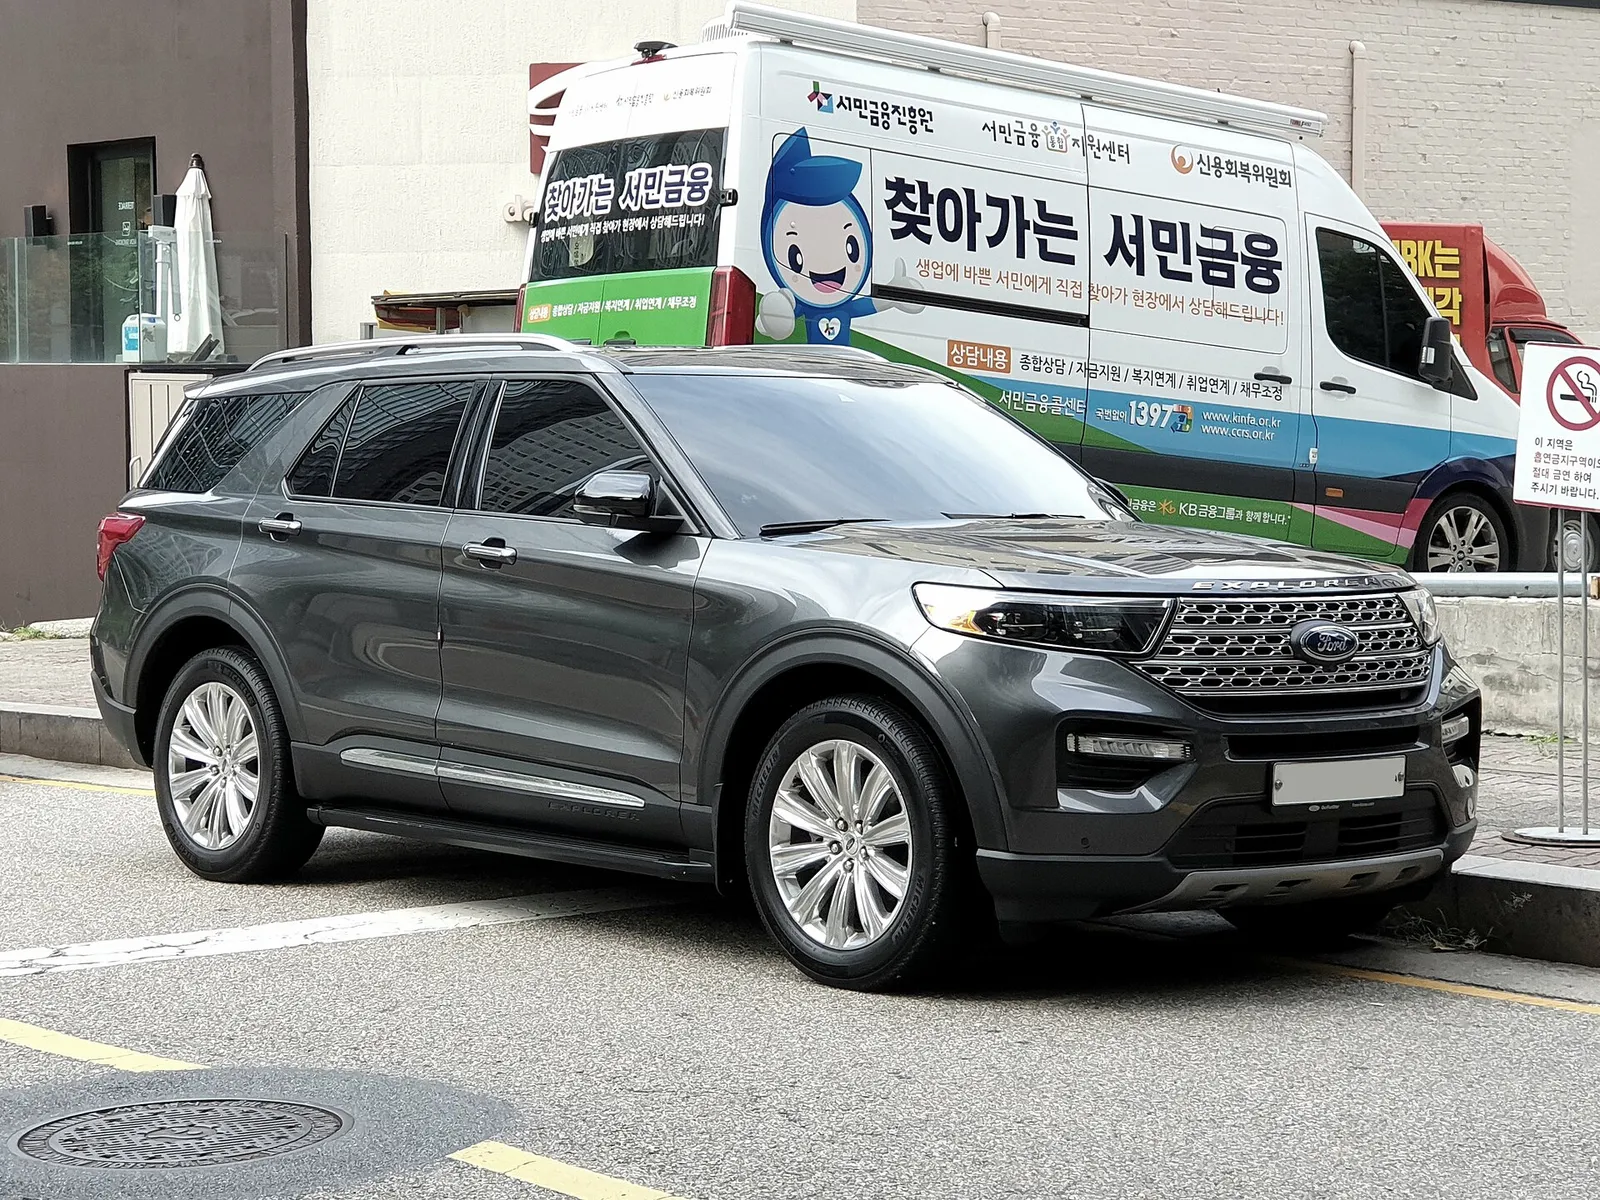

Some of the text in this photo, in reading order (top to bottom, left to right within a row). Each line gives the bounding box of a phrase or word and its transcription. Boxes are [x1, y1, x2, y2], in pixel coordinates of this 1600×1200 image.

[836, 95, 934, 135] 서민금융진흥원
[982, 120, 1041, 149] 서민금융
[1071, 134, 1131, 165] 지원센터
[1196, 154, 1292, 189] 신용회복위원회
[545, 163, 712, 223] 찾아가는 서민금융
[650, 212, 705, 229] 상담해드립니다!
[884, 176, 1283, 295] 찾아가는 서민금융
[915, 259, 1285, 327] 생업에 바쁜 서민에게 직접 찾아가 현장에서 상담해드립니다!
[950, 343, 1009, 371] 상담내용
[1019, 352, 1066, 377] 종합상담
[1076, 362, 1122, 384] 자금지원
[1131, 369, 1177, 391] 복지연계
[1186, 376, 1231, 397] 취업연계
[1240, 382, 1284, 403] 채무조정
[998, 391, 1087, 418] 서민금융콜센터
[1095, 407, 1128, 424] 국번없이
[1128, 400, 1174, 430] 1397
[1200, 424, 1276, 442] www.ccrs.or.kr
[1202, 410, 1282, 429] www.kinfa.or.kr
[1534, 437, 1574, 451] 이 지역은
[1532, 467, 1592, 484] 절대 금연 하여
[1530, 482, 1600, 500] 주시기 바랍니다.
[1192, 576, 1379, 590] EXPLORER
[1317, 631, 1352, 652] Ford
[549, 802, 640, 821] EXPLORER
